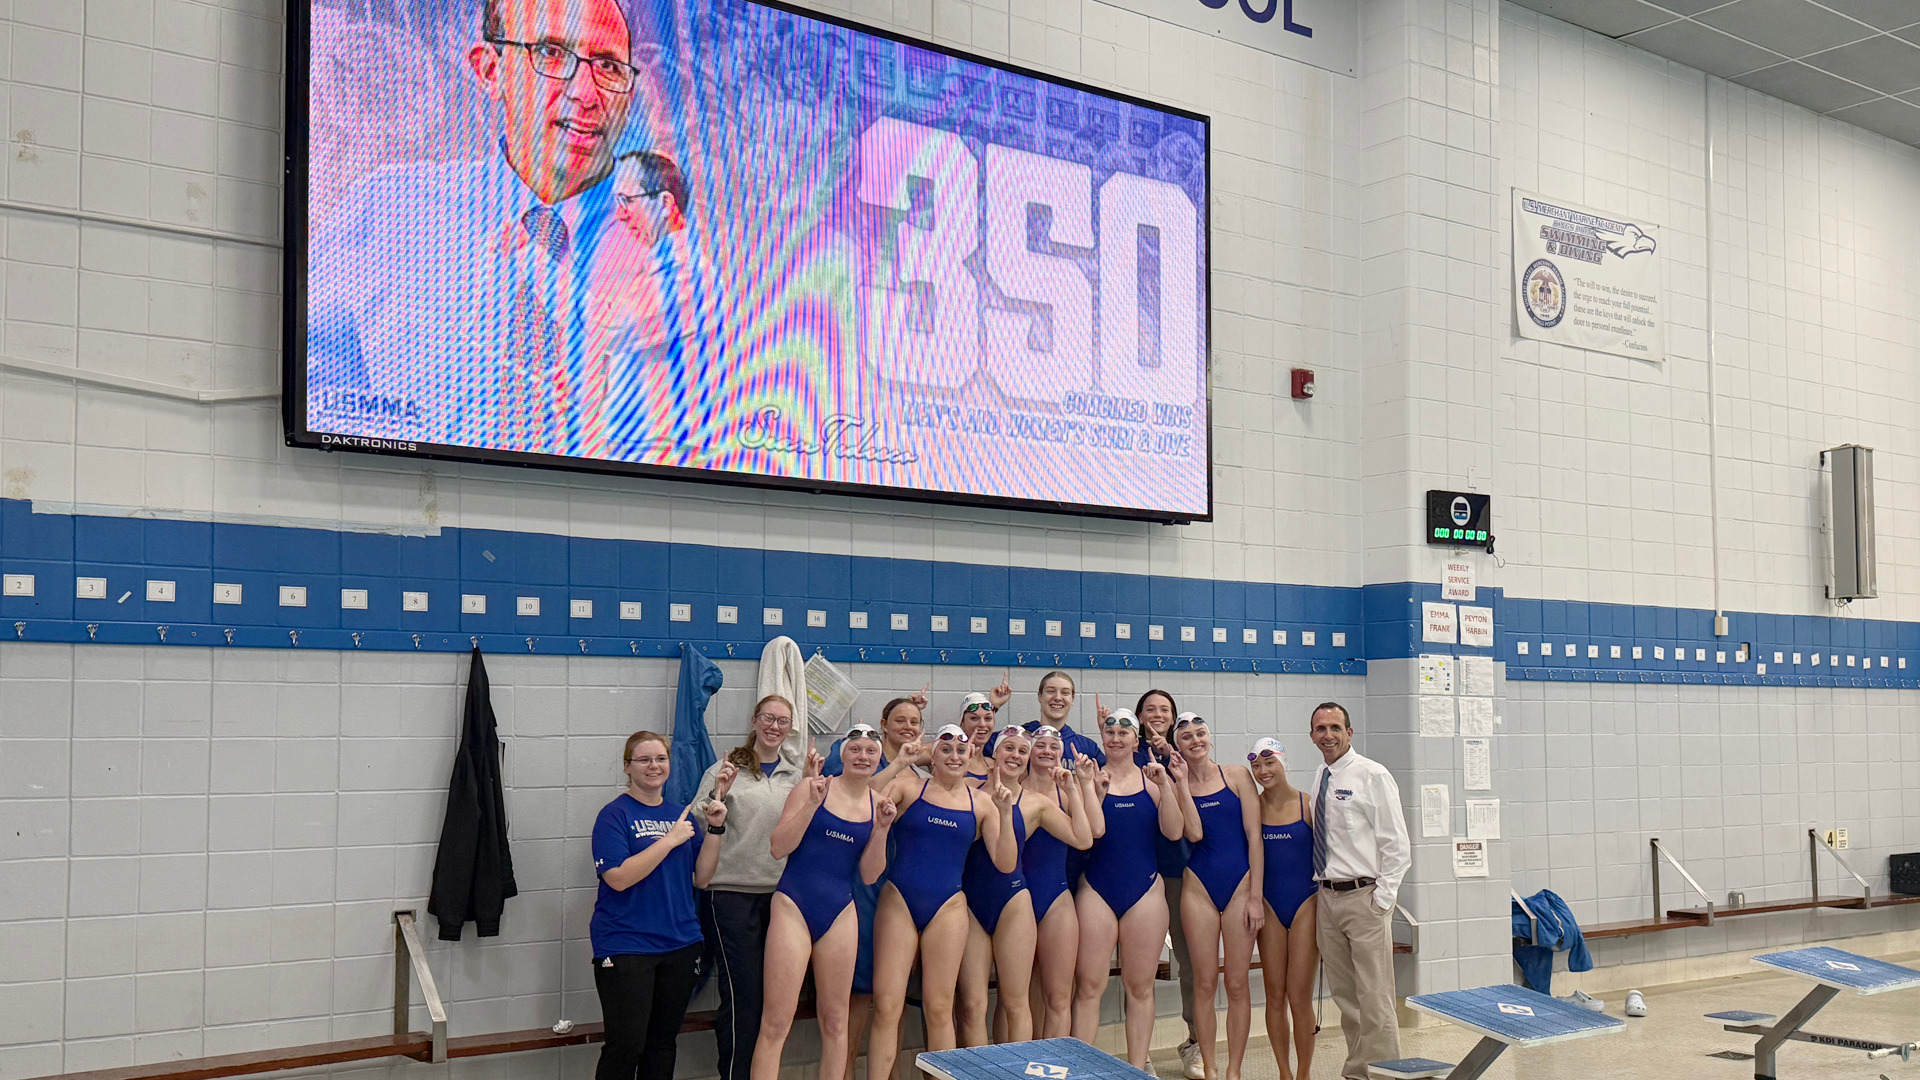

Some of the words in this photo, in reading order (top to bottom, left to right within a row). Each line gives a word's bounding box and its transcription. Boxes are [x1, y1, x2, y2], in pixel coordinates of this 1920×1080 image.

[1538, 203, 1571, 220] MERCHANT
[1571, 212, 1597, 226] MARINE
[1597, 219, 1626, 235] ACADEMY
[1540, 225, 1606, 254] SWIMMING
[856, 114, 1198, 402] 350
[1546, 240, 1556, 254] &
[1557, 242, 1603, 265] DIVING
[1586, 281, 1595, 289] will
[1620, 288, 1633, 297] desire
[1582, 294, 1592, 303] urge
[1593, 295, 1598, 303] to
[1599, 297, 1611, 305] reach
[1612, 300, 1622, 308] your
[1574, 304, 1586, 313] these
[1603, 309, 1613, 320] keys
[1614, 312, 1622, 320] that
[1623, 314, 1631, 322] will
[1632, 317, 1646, 326] unlock
[1647, 319, 1655, 327] the
[1574, 317, 1585, 326] door
[1591, 321, 1610, 331] personal
[323, 390, 420, 419] USMMA
[1063, 390, 1149, 423] COMBINED
[1152, 402, 1193, 429] WINS
[963, 408, 1000, 435] AND
[1006, 412, 1086, 445] WOMEN'S
[1137, 429, 1151, 453] &
[1154, 431, 1192, 457] DIVE
[321, 434, 417, 452] DAKTRONICS
[1447, 563, 1470, 572] WEEKLY
[1447, 575, 1470, 585] SERVICE
[1447, 588, 1470, 597] AWARD
[1430, 610, 1450, 619] EMMA
[1464, 614, 1488, 623] PEYTON
[1429, 623, 1451, 633] FRANK
[1465, 627, 1488, 636] HARBIN
[927, 815, 958, 828] USMMA
[825, 829, 854, 843] USMMA
[1827, 831, 1834, 847] 4
[1459, 843, 1480, 851] DANGER
[1818, 1036, 1835, 1045] KDI
[1837, 1039, 1882, 1051] PARAGON
[1028, 1063, 1063, 1078] 2
